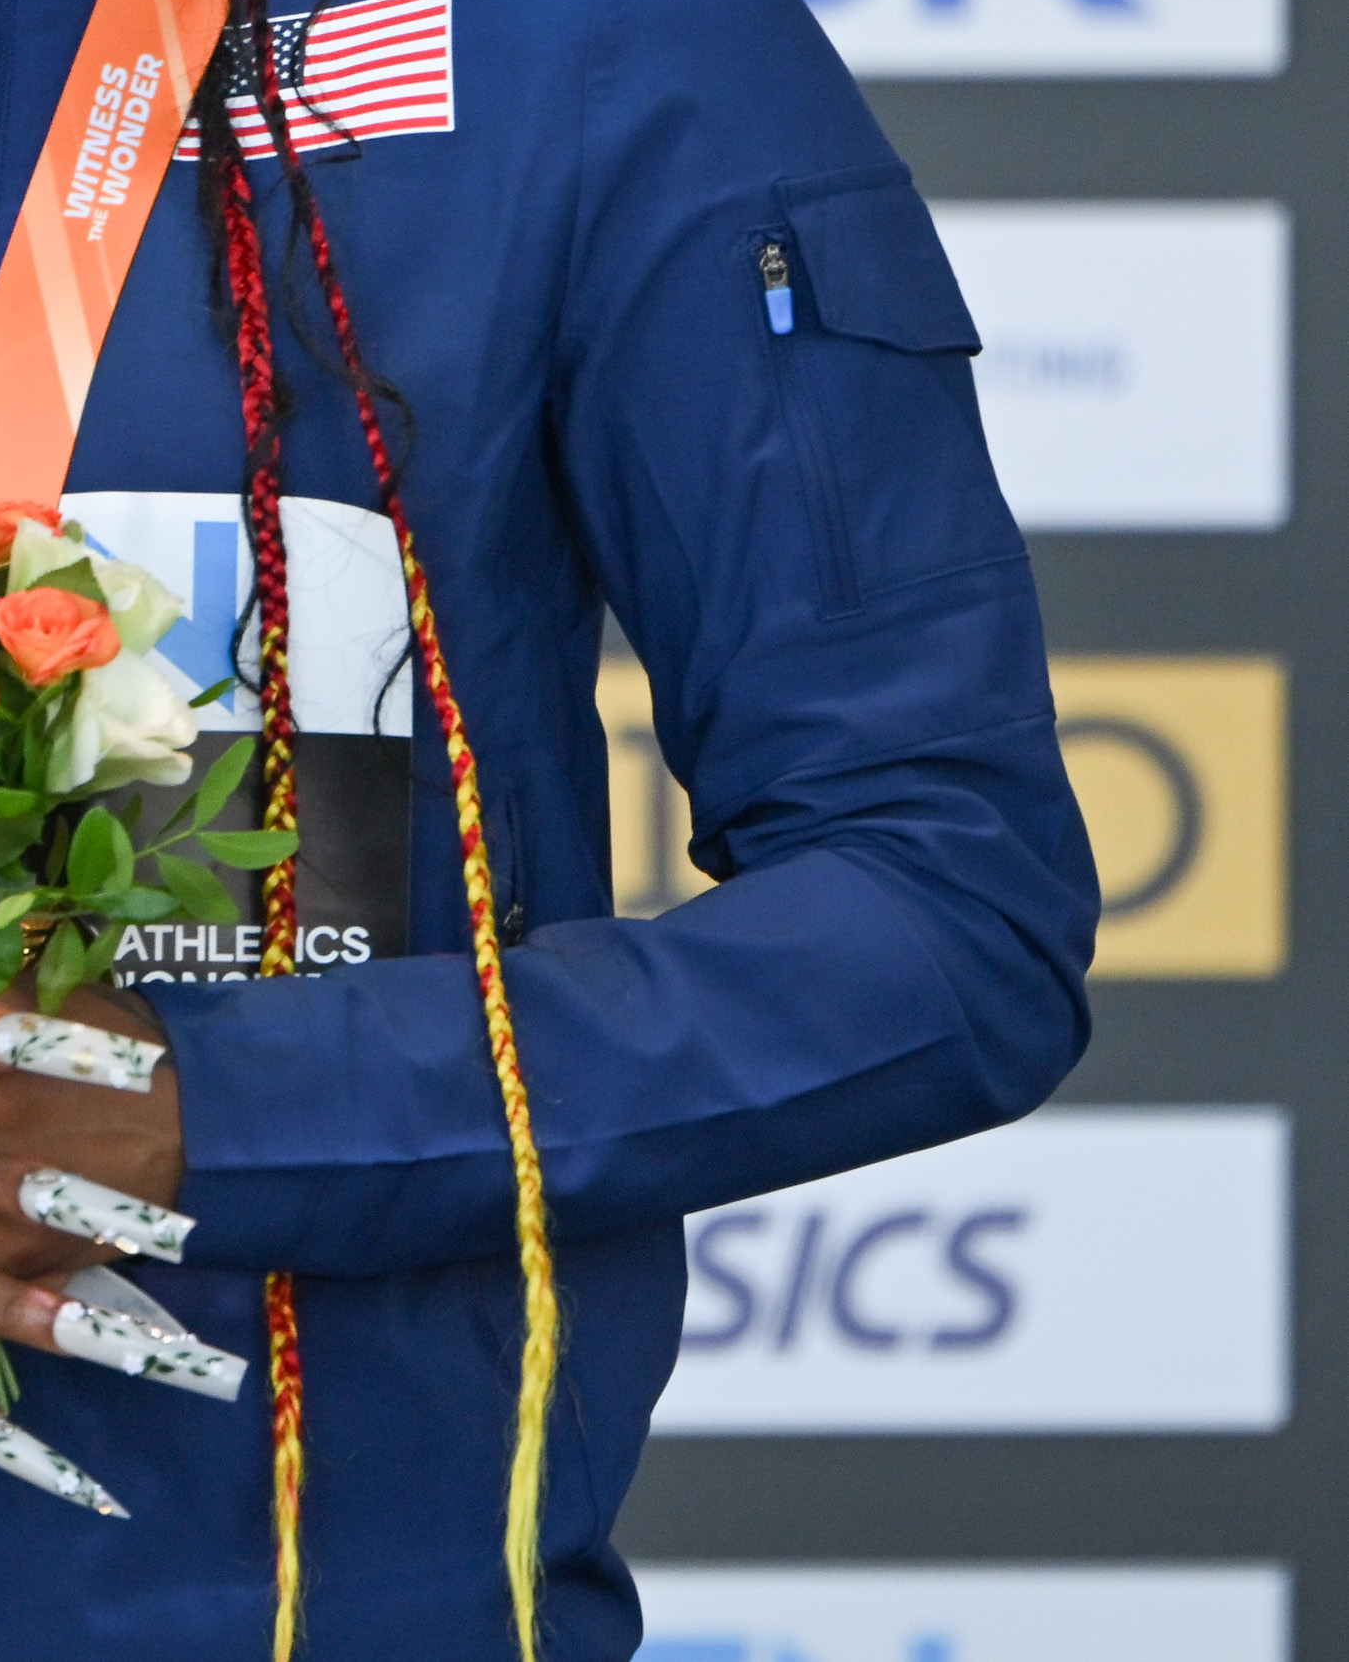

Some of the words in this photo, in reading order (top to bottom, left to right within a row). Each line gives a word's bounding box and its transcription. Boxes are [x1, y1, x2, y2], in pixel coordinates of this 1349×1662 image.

[63, 63, 129, 218] WITNESS
[98, 53, 165, 206] WONDER
[87, 208, 110, 242] THE
[113, 924, 372, 965] ATHLEICS
